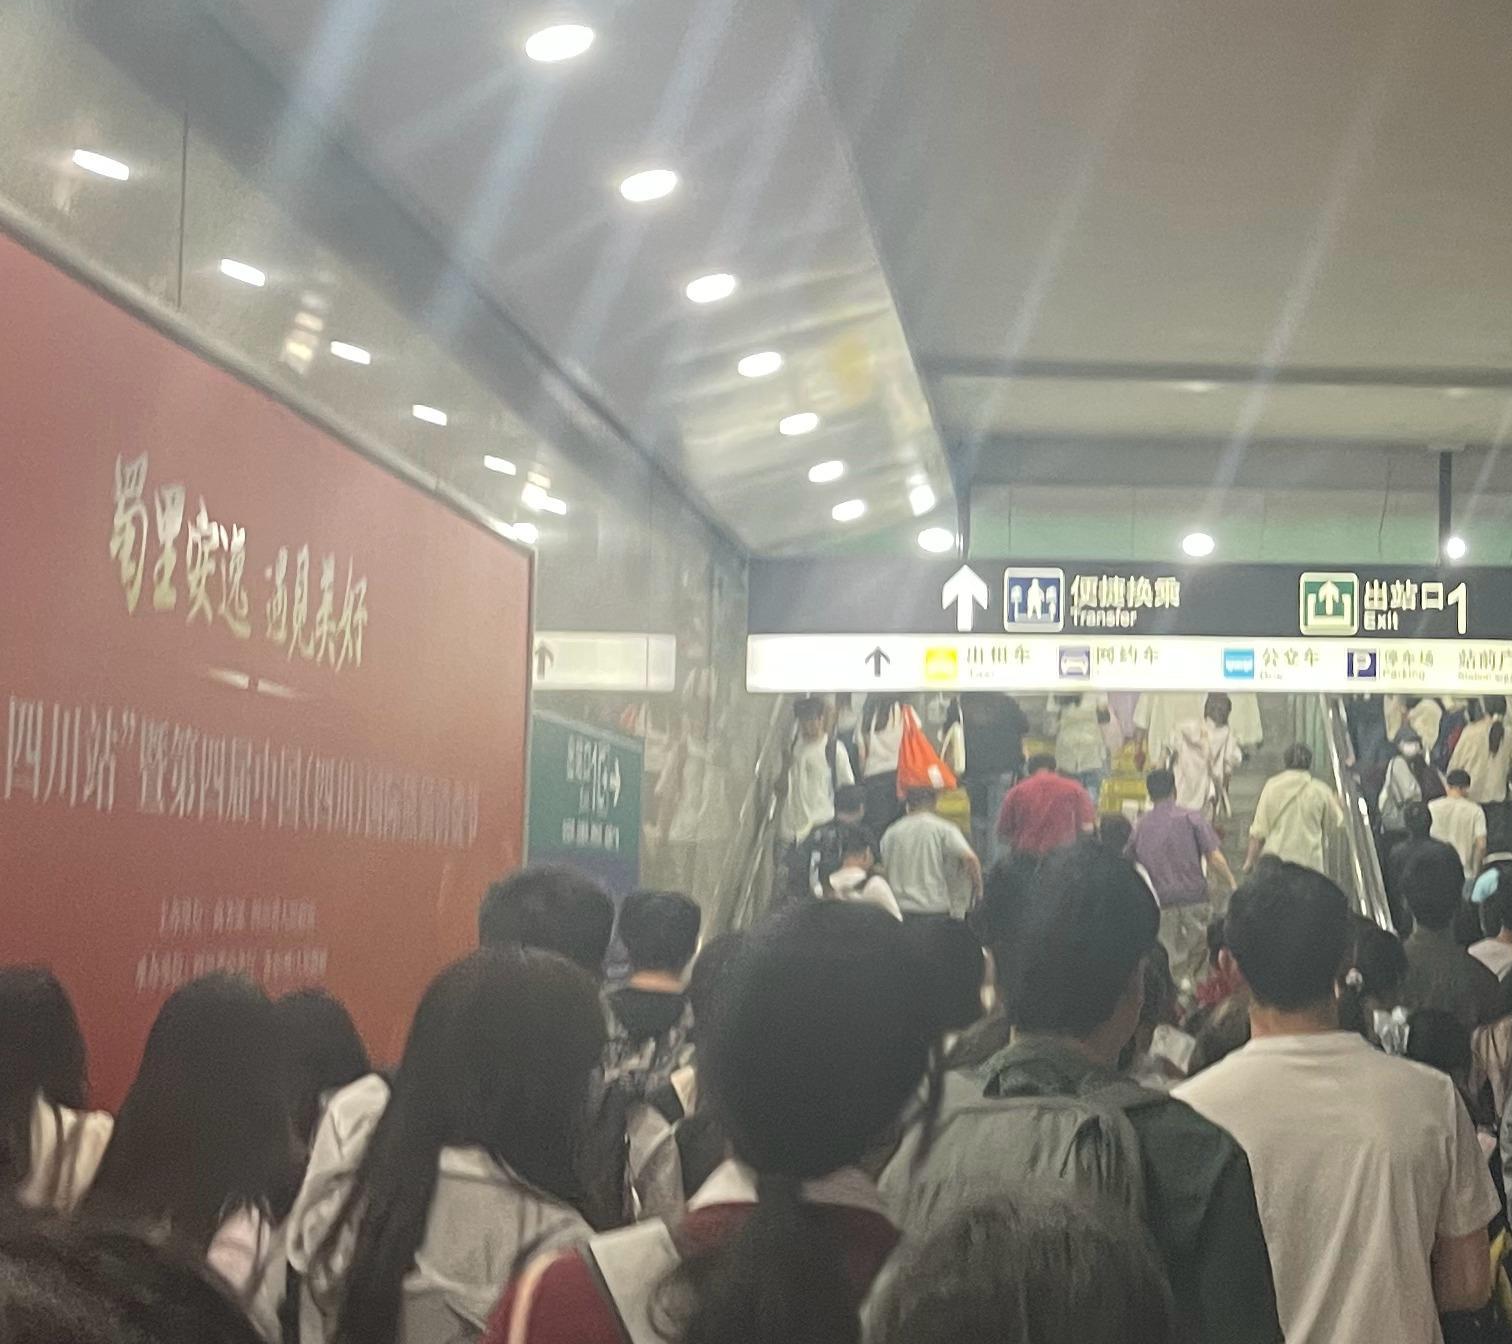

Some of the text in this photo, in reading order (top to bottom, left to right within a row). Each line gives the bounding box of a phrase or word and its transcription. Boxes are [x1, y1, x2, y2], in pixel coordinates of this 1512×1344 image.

[1070, 574, 1180, 609] 便捷换乘
[1364, 610, 1399, 631] Exit
